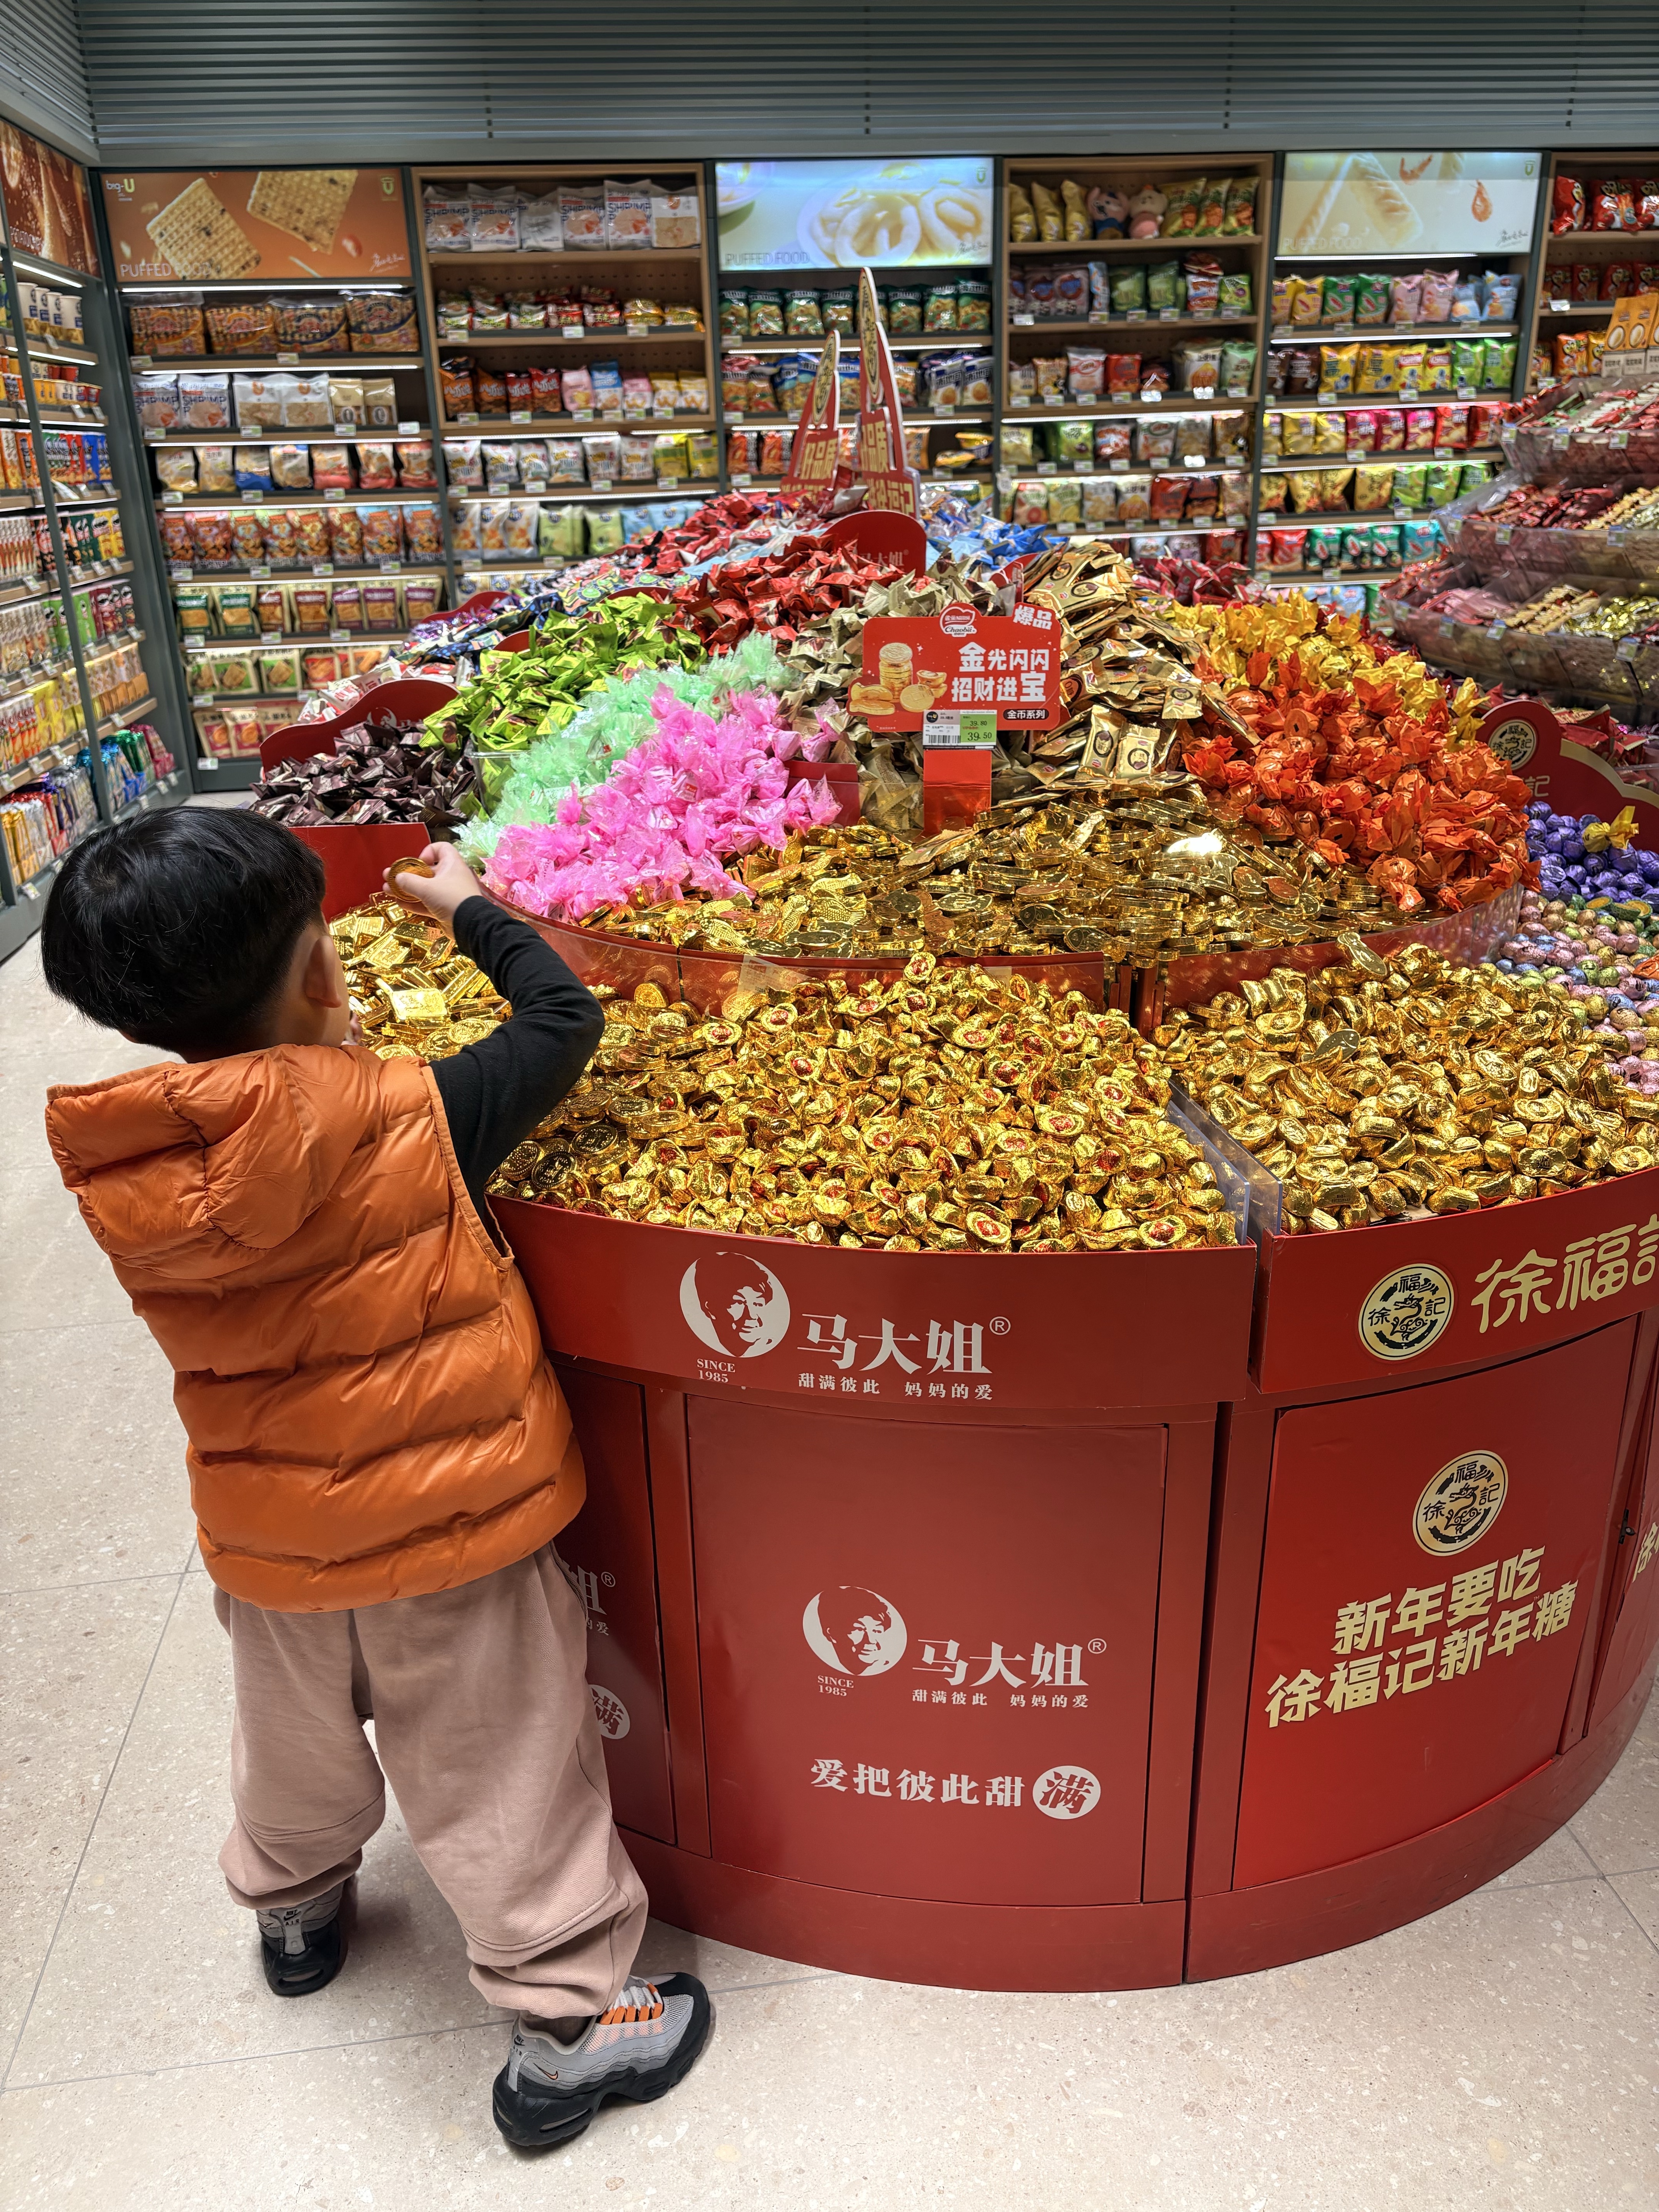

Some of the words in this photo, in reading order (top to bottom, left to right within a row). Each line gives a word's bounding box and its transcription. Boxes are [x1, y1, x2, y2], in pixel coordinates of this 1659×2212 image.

[119, 263, 172, 277] PUFFED
[726, 252, 773, 266] PUFFED
[775, 251, 809, 264] FOOD
[1013, 605, 1053, 630] 爆品
[958, 641, 1049, 672] 金光闪闪
[951, 671, 1046, 702] 招财进宝
[1007, 709, 1045, 720] 金币系列
[797, 1314, 993, 1375] 马大姐
[697, 1358, 735, 1373] SINCE
[698, 1370, 729, 1384] 1985
[798, 1372, 880, 1395] 甜满彼此
[904, 1381, 993, 1401] 妈妈的爱
[1632, 1522, 1659, 1583] 徐
[1331, 1546, 1546, 1656] 新年要吃
[912, 1639, 1089, 1689] 马大姐
[1264, 1580, 1579, 1728] 徐福记新年糖
[817, 1675, 854, 1689] SINCE
[818, 1685, 847, 1697] 1985
[912, 1689, 988, 1706] 甜满彼此
[1010, 1694, 1089, 1709] 妈妈的爱
